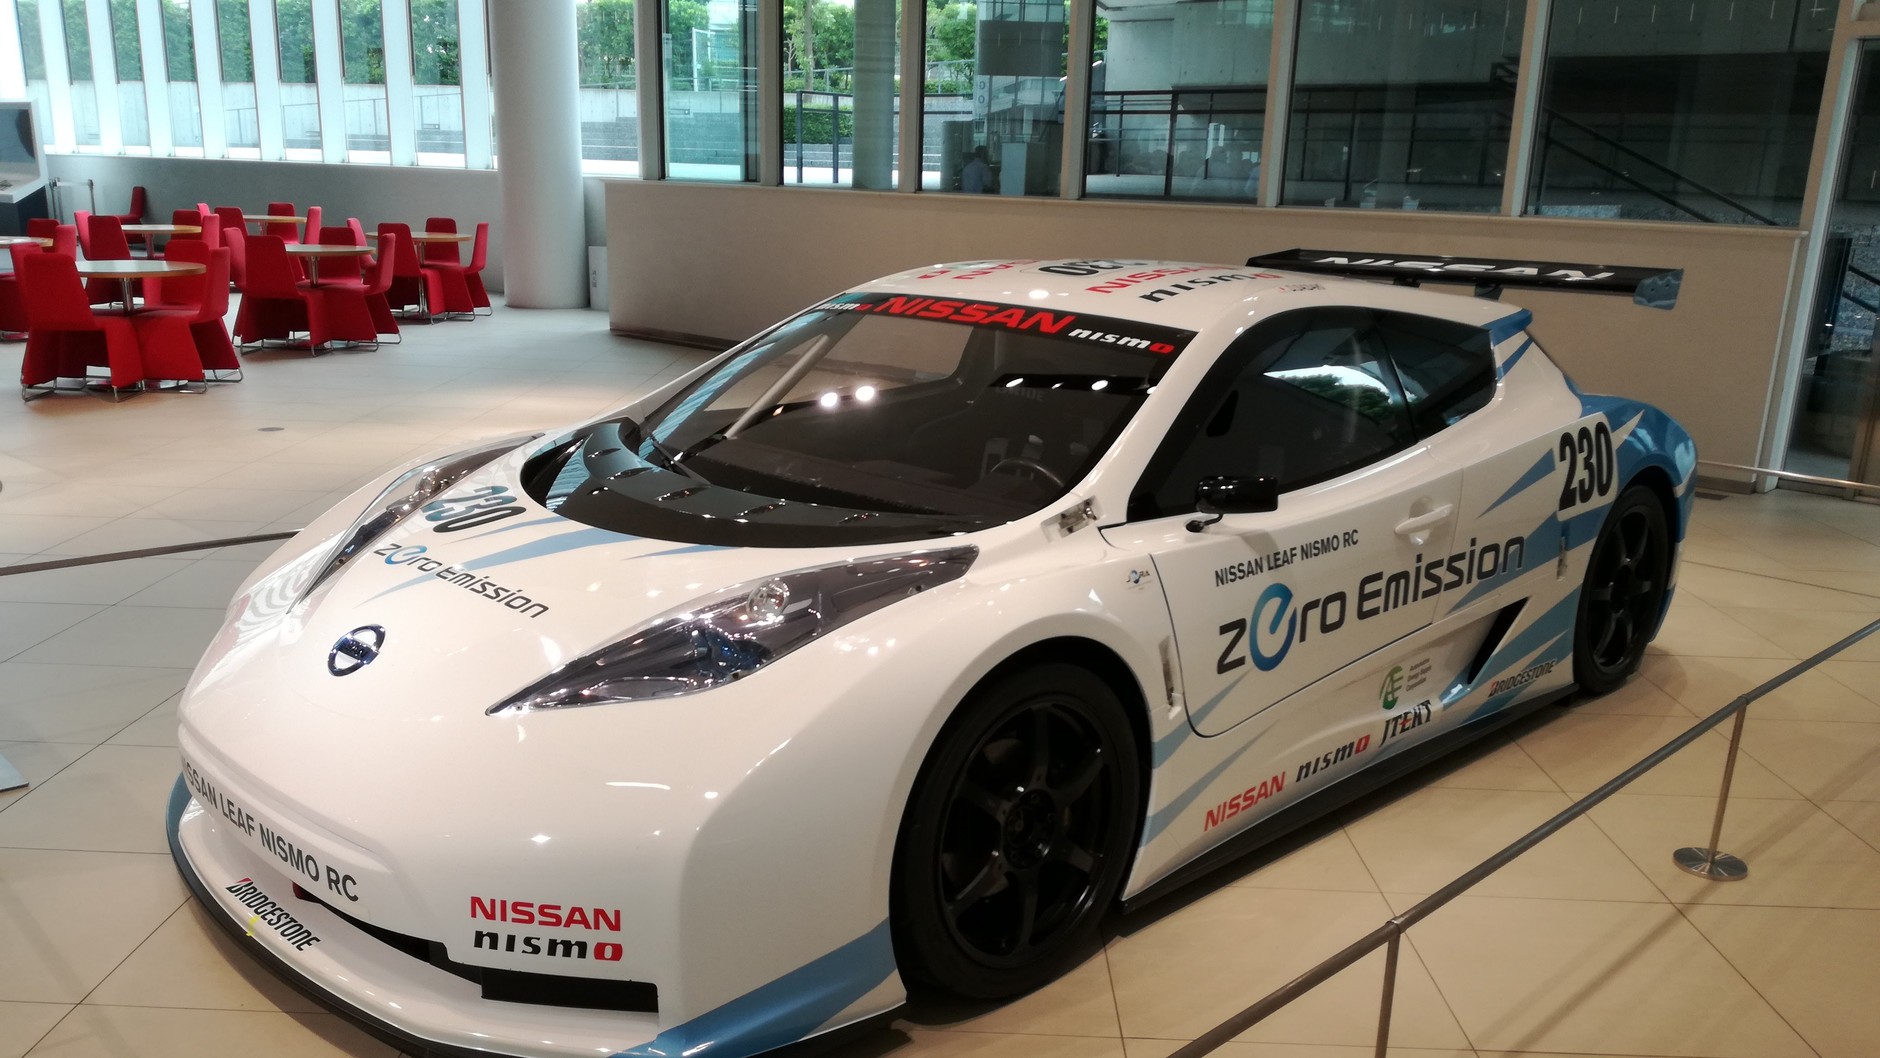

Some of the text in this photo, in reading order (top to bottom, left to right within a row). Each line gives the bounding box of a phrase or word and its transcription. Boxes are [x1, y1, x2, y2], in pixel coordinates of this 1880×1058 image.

[1139, 273, 1283, 302] nismo
[1314, 256, 1615, 281] NISSAN
[873, 296, 1076, 334] NISSAN
[1068, 328, 1175, 354] nismo
[1558, 421, 1614, 512] 230
[420, 486, 527, 533] 230
[1215, 529, 1359, 587] NISSAN LEAF NISMO RC
[1357, 535, 1525, 620] Emission
[435, 566, 549, 618] Emission
[1488, 660, 1556, 698] BRIDGESTONE
[1379, 699, 1432, 748] JTEKT
[1203, 734, 1370, 832] NISSAN nismo
[182, 757, 359, 902] SSAN LEAF NISMO RC
[226, 877, 321, 952] BRIDGESTONE
[470, 896, 621, 931] NISSAN
[473, 930, 624, 962] nismo
